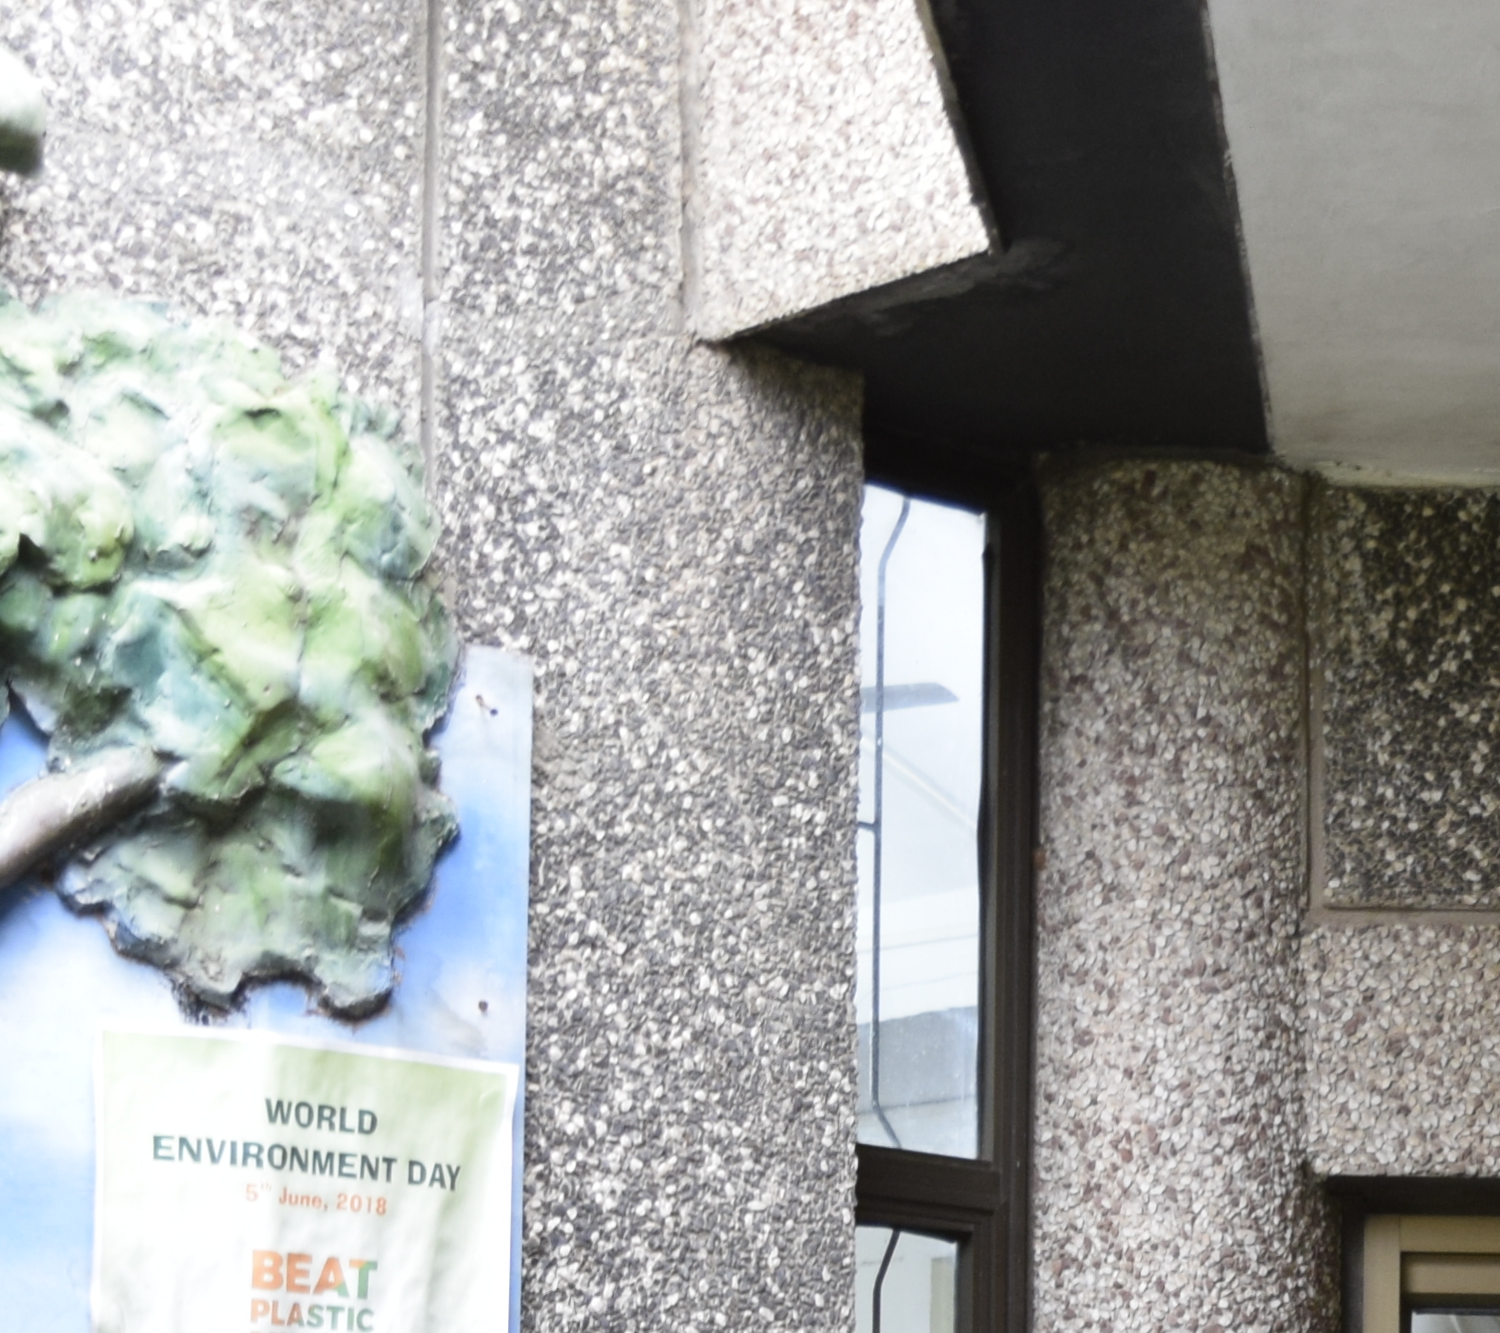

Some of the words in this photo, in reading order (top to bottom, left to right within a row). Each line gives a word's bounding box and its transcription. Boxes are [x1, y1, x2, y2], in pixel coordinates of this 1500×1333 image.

[265, 1098, 378, 1135] WORLD
[152, 1135, 398, 1184] ENVIRONMENT
[407, 1160, 461, 1191] DAY
[278, 1187, 328, 1212] June,
[336, 1192, 388, 1217] 2018
[251, 1250, 378, 1300] BEAT
[250, 1299, 375, 1333] PLASTIC
